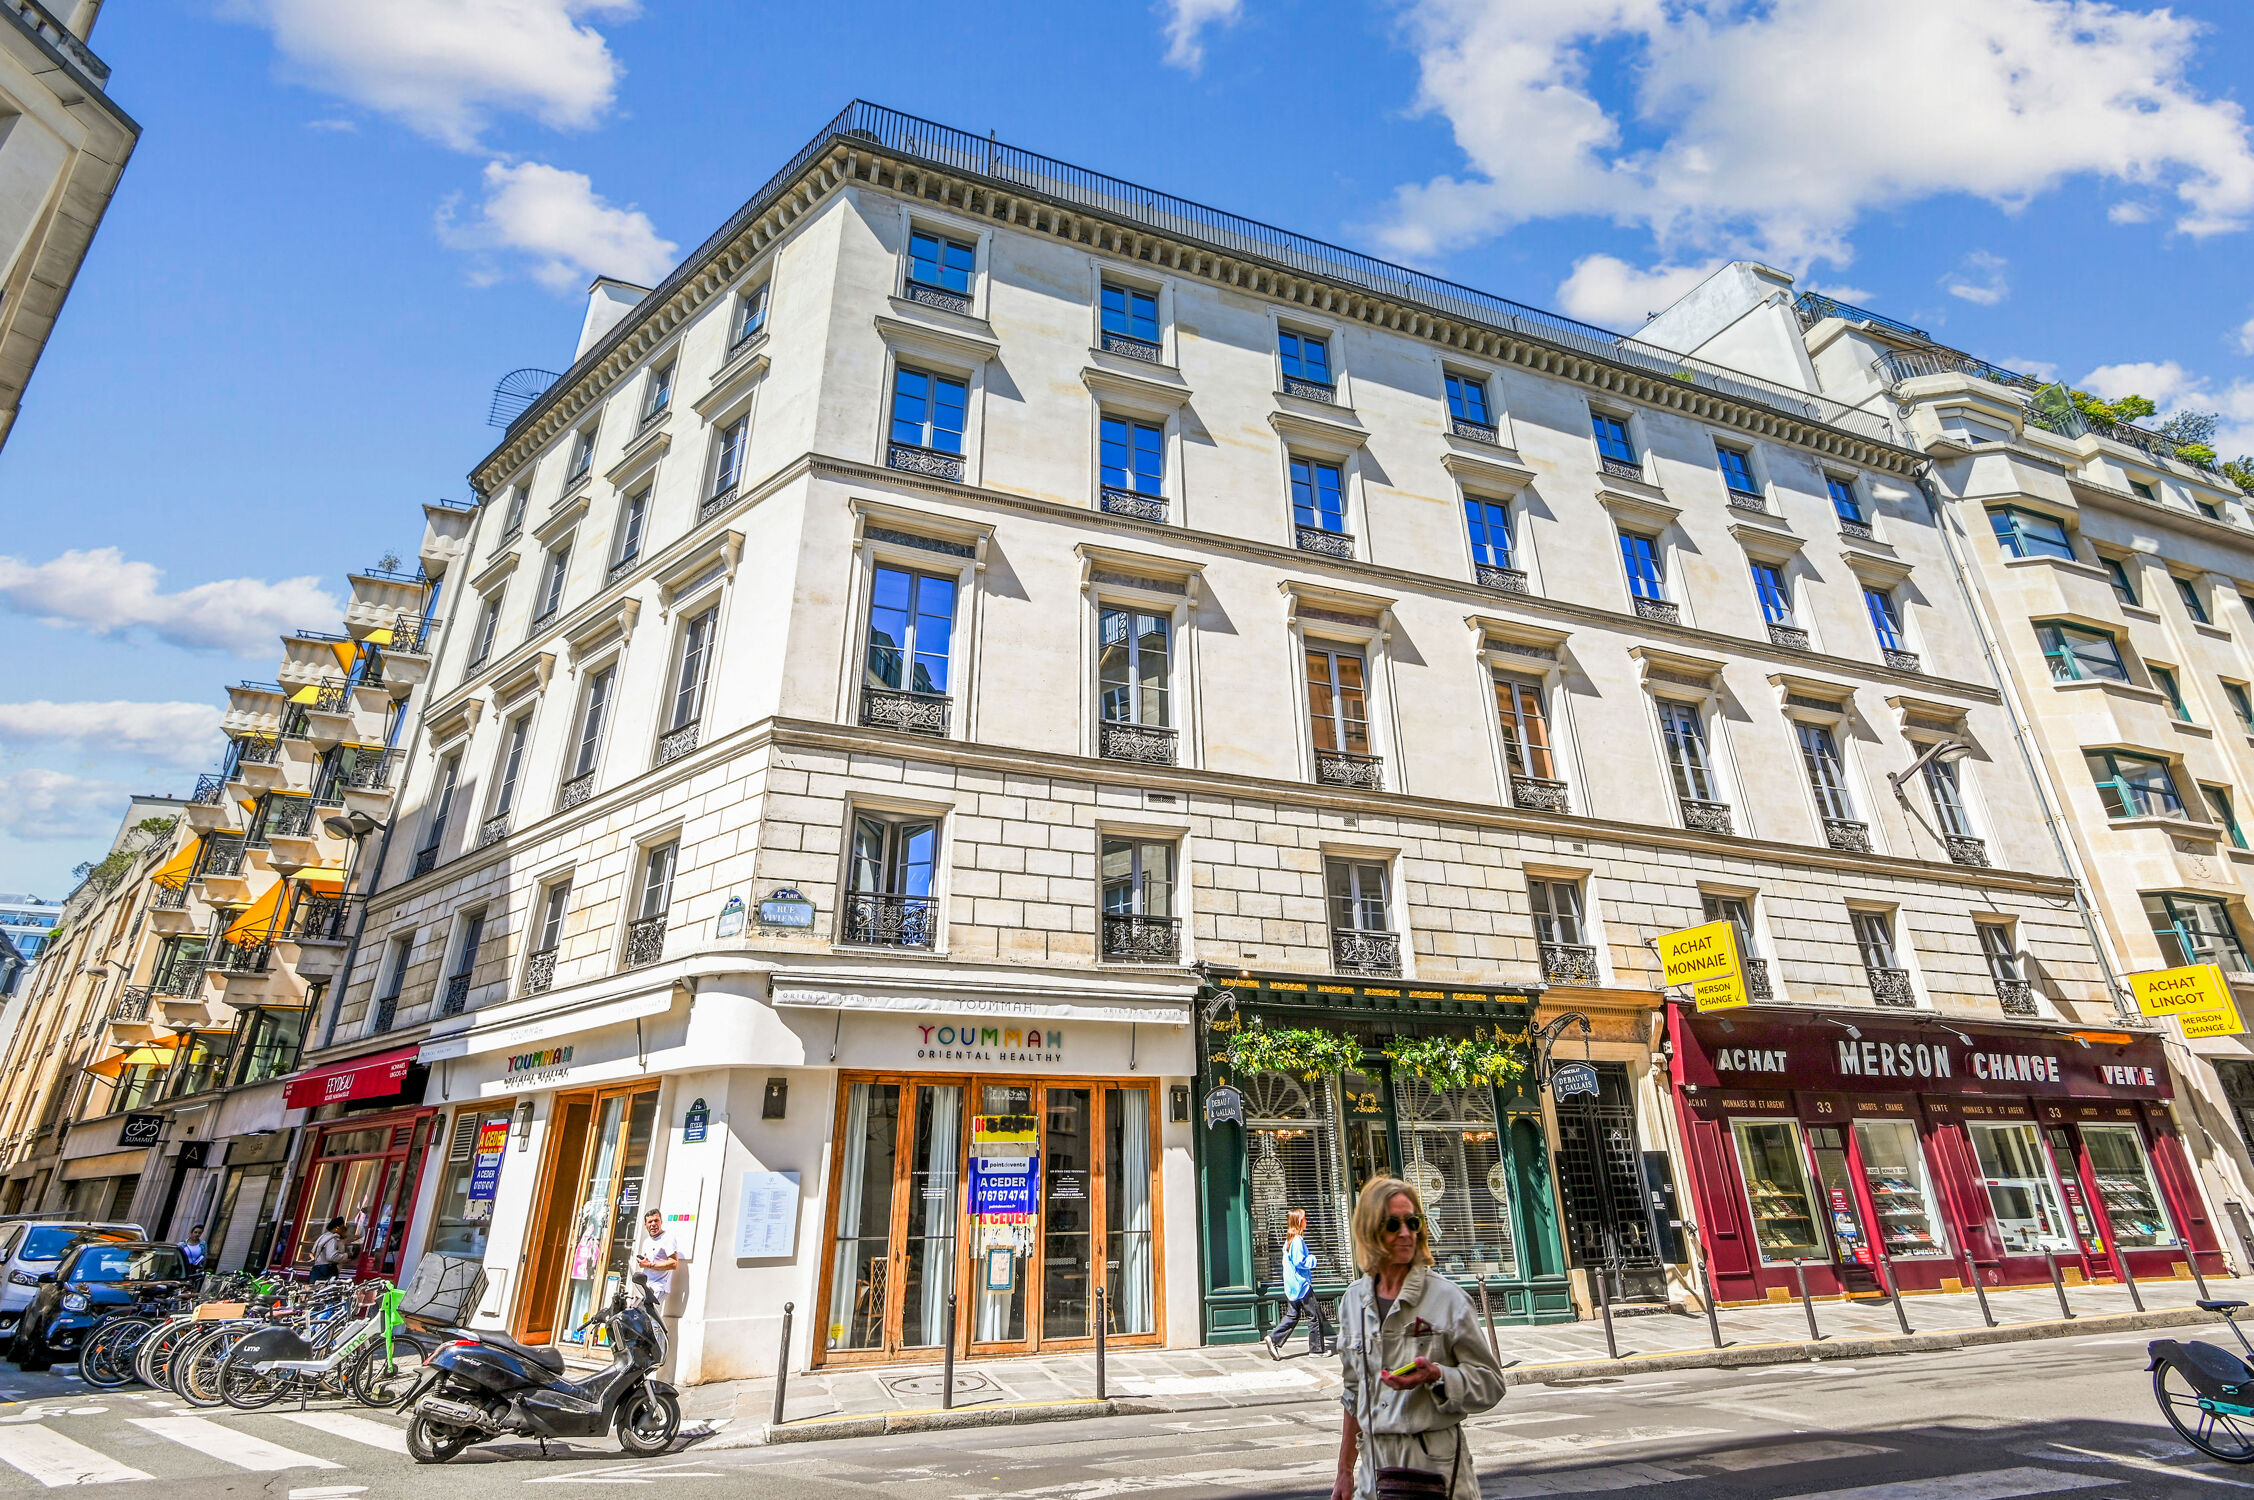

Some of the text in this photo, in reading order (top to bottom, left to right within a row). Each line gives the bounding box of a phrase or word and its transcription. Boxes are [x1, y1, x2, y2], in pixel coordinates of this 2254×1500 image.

[777, 905, 796, 914] RUE
[763, 913, 805, 923] VIVIENNE
[1672, 936, 1712, 957] ACHAT
[1667, 953, 1727, 977] MONNAIE
[1697, 982, 1731, 995] MERSON
[2148, 976, 2196, 993] ACHAT
[957, 998, 1033, 1013] YOUMMAH
[1699, 994, 1733, 1007] CHANGE
[2150, 991, 2205, 1009] LINGOT
[2182, 1014, 2222, 1025] MERSON
[2186, 1023, 2226, 1034] CHANGE
[918, 1025, 1062, 1049] YOUMMAH
[507, 1045, 574, 1073] YOUMMAH
[917, 1049, 1062, 1062] ORIENTAL HEALTHY
[1717, 1048, 1788, 1073] ACHAT
[1838, 1040, 2060, 1082] MERSON CHANGE
[1558, 1073, 1589, 1085] DEBAUVE
[2101, 1065, 2155, 1086] VENTE
[1565, 1080, 1593, 1092] GALLAIS
[1688, 1098, 1707, 1107] ACHAT
[1722, 1099, 1785, 1109] MONNAIES OR ET ARGENT
[1816, 1101, 1833, 1114] 33
[1858, 1102, 1904, 1112] LINGOTS CHANGE
[1929, 1103, 1949, 1113] VENTE
[1961, 1105, 1985, 1114] MONNAIES
[1998, 1106, 2006, 1115] ET
[2007, 1106, 2025, 1115] ARGENT
[2048, 1107, 2063, 1119] 33
[124, 1135, 154, 1143] SUMMIT
[479, 1130, 506, 1147] A CEDER
[989, 1161, 1026, 1169] pointdevente
[980, 1177, 1026, 1188] A CEDER
[978, 1190, 1028, 1201] 07 67 67 47 47
[979, 1212, 1030, 1225] A CEDER
[338, 1332, 368, 1358] Lime
